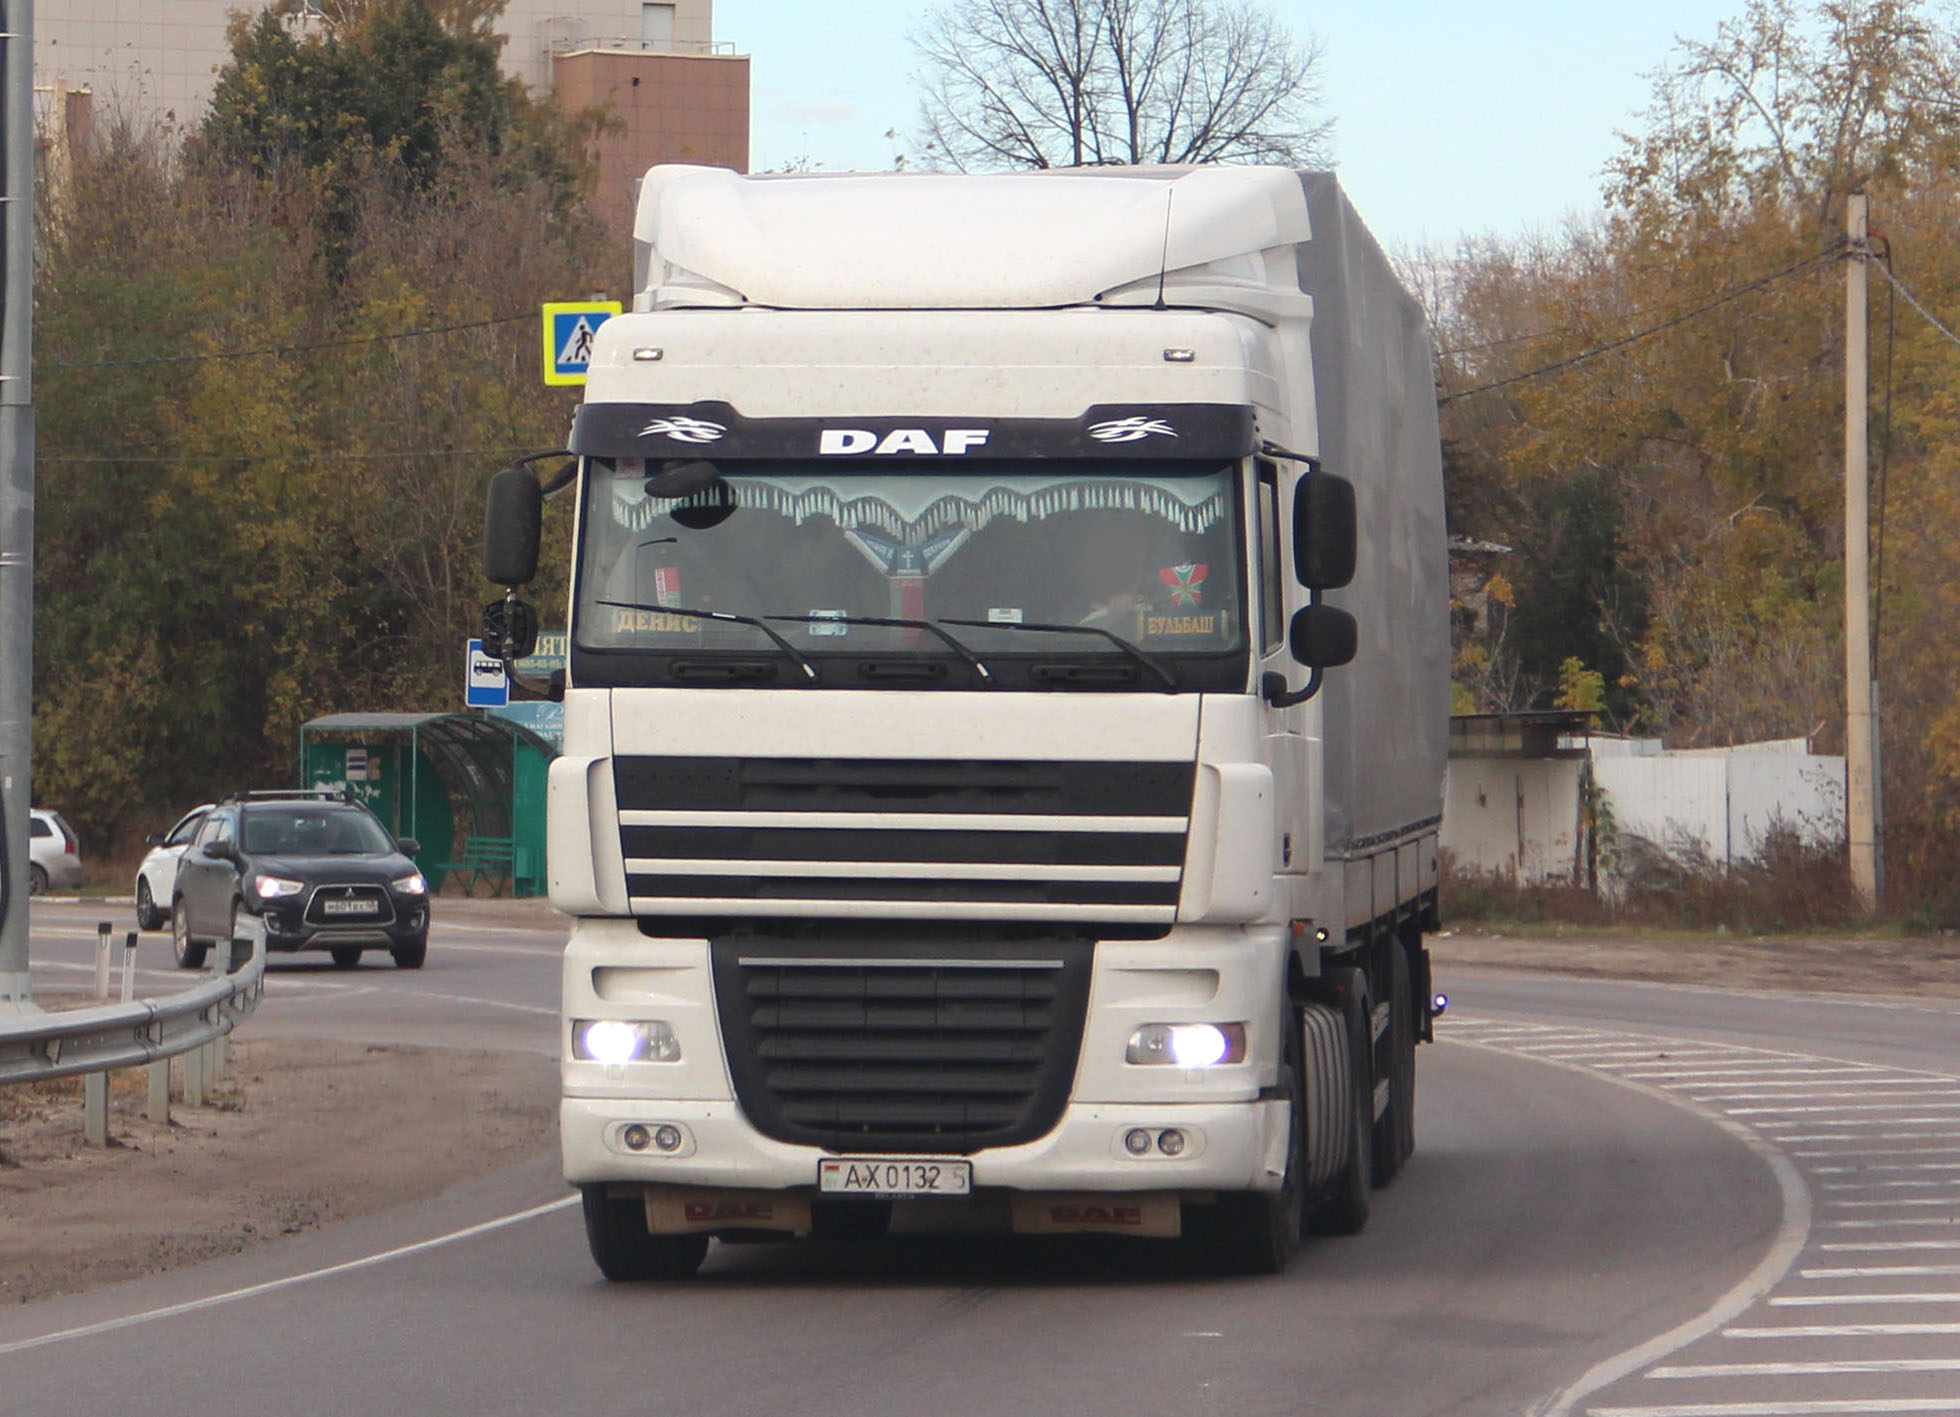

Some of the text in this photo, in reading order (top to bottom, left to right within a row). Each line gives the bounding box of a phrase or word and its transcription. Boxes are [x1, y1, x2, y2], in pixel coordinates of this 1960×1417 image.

[820, 429, 990, 454] DAF
[617, 611, 699, 633] ДЕНИС
[1147, 615, 1214, 635] БУЛЬБАШ
